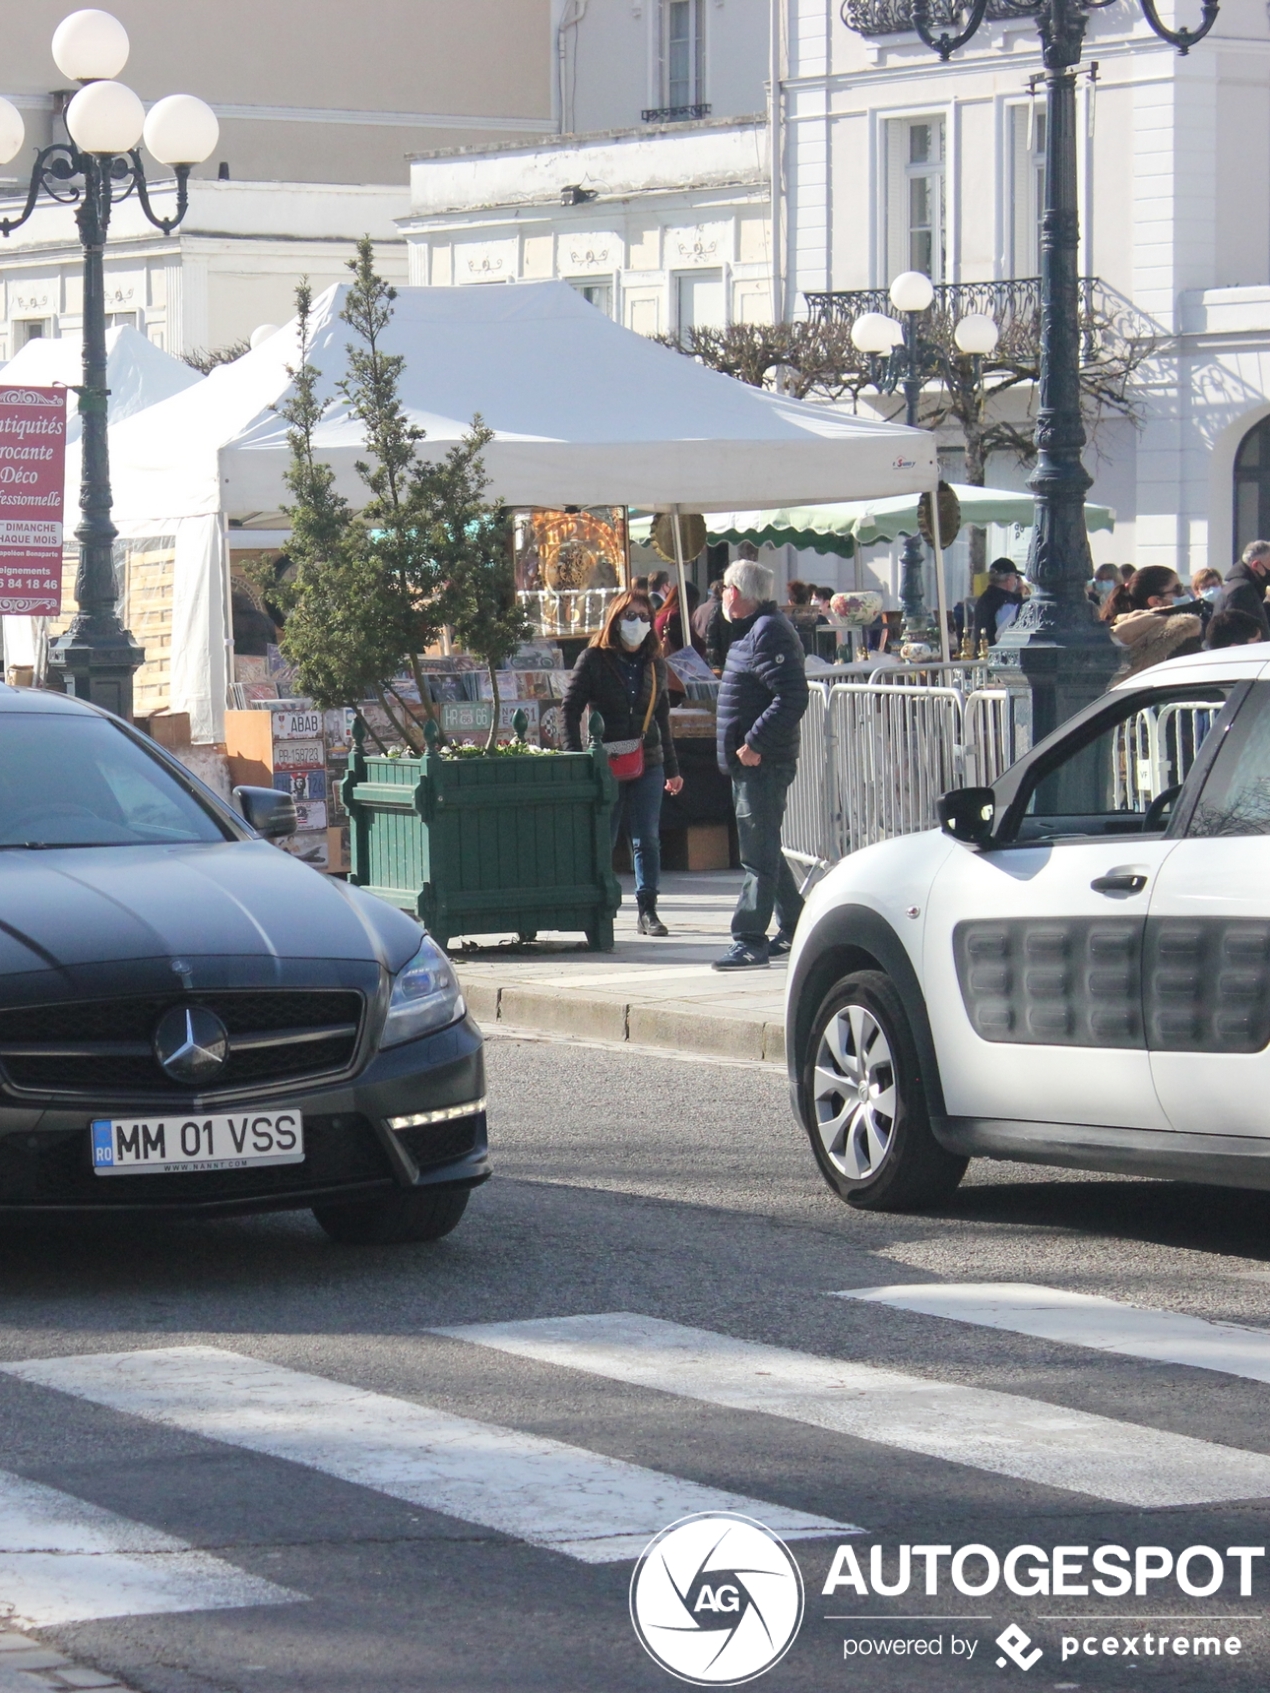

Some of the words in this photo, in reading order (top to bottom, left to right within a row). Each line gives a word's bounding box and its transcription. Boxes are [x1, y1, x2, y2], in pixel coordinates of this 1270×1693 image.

[0, 466, 38, 484] Déco
[6, 523, 56, 532] DIMANCHE
[33, 535, 57, 544] MOIS
[26, 550, 58, 558] Bonaparte
[7, 579, 22, 588] 84
[26, 579, 40, 589] 18
[43, 579, 58, 589] 46
[291, 715, 318, 733] ABAB
[96, 1147, 112, 1161] RO
[116, 1123, 166, 1161] MM
[181, 1119, 214, 1157] 01
[228, 1115, 297, 1153] VSS
